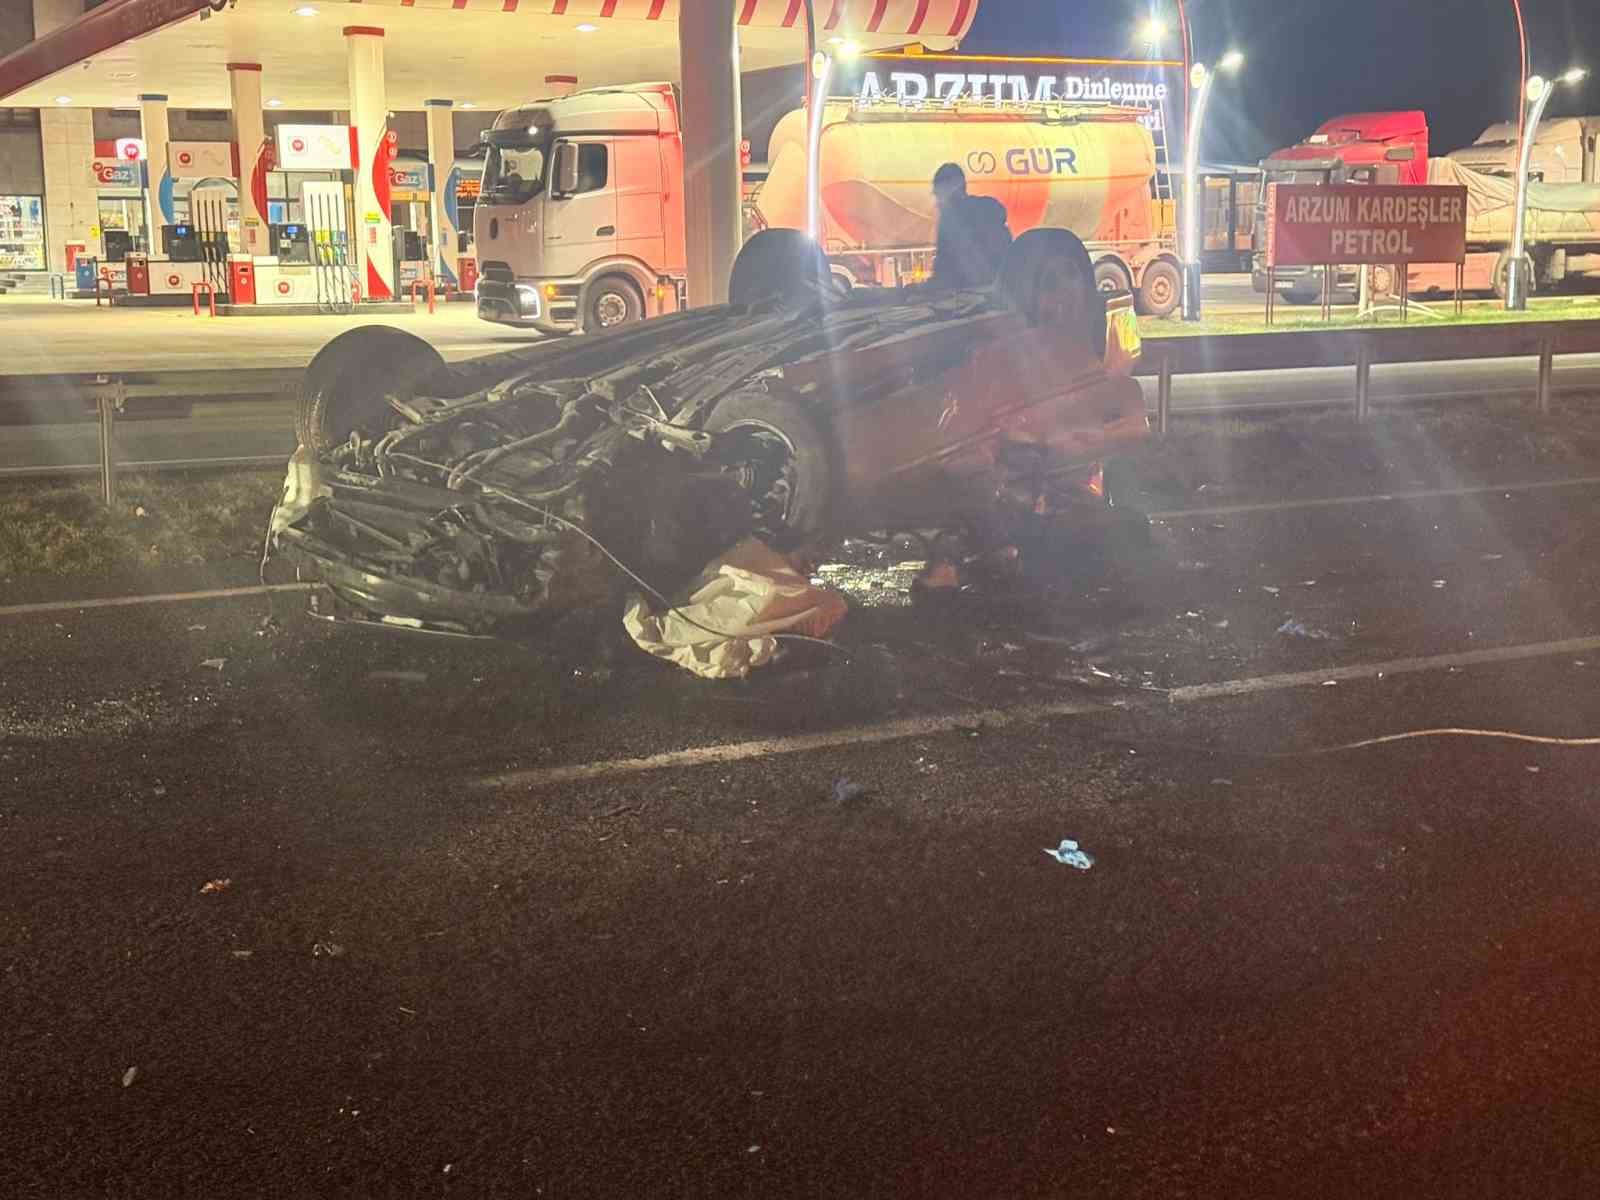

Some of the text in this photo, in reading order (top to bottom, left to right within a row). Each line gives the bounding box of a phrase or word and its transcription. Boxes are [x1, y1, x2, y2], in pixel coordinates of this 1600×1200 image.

[1065, 76, 1167, 100] Dinlenme
[103, 167, 130, 180] Gaz
[1006, 148, 1078, 176] GÜR
[1285, 195, 1462, 230] ARZUM KARDEŞLER
[1331, 229, 1414, 254] PETROL
